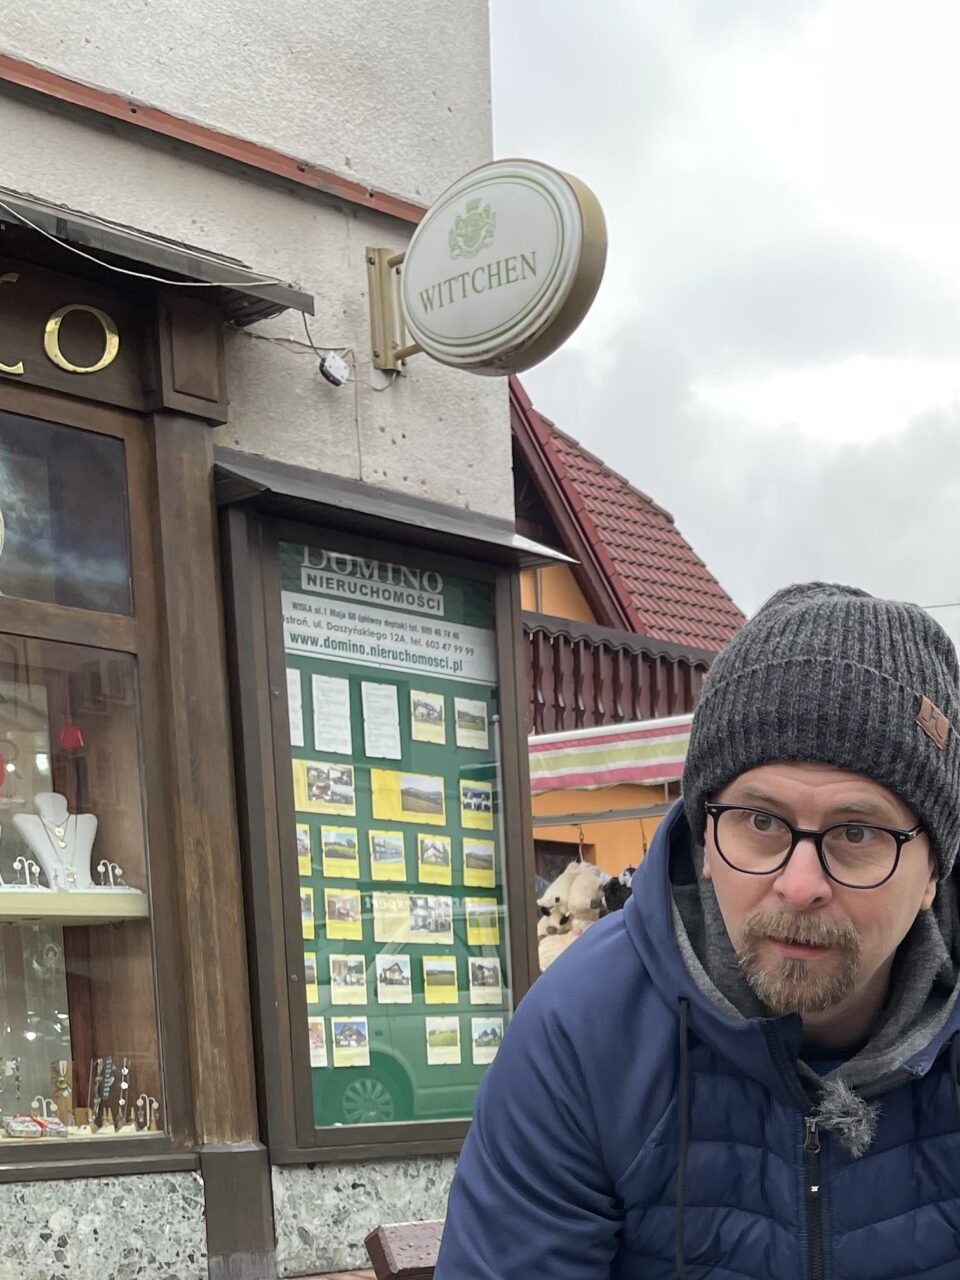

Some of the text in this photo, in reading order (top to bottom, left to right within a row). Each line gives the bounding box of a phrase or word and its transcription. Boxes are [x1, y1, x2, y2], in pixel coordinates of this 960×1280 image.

[419, 252, 537, 314] WITTCHEN
[301, 545, 444, 594] DOMINO
[306, 573, 441, 611] NIERUCHOMOŚCI
[282, 614, 311, 628] stroń,
[313, 620, 324, 629] ul.
[326, 621, 388, 641] Daszyńskiego
[410, 636, 422, 646] tel.
[425, 640, 440, 650] 603
[442, 642, 452, 651] 47
[453, 644, 463, 654] 99
[465, 647, 475, 656] 99
[289, 632, 463, 673] www.domino.nieruchomosci.pl
